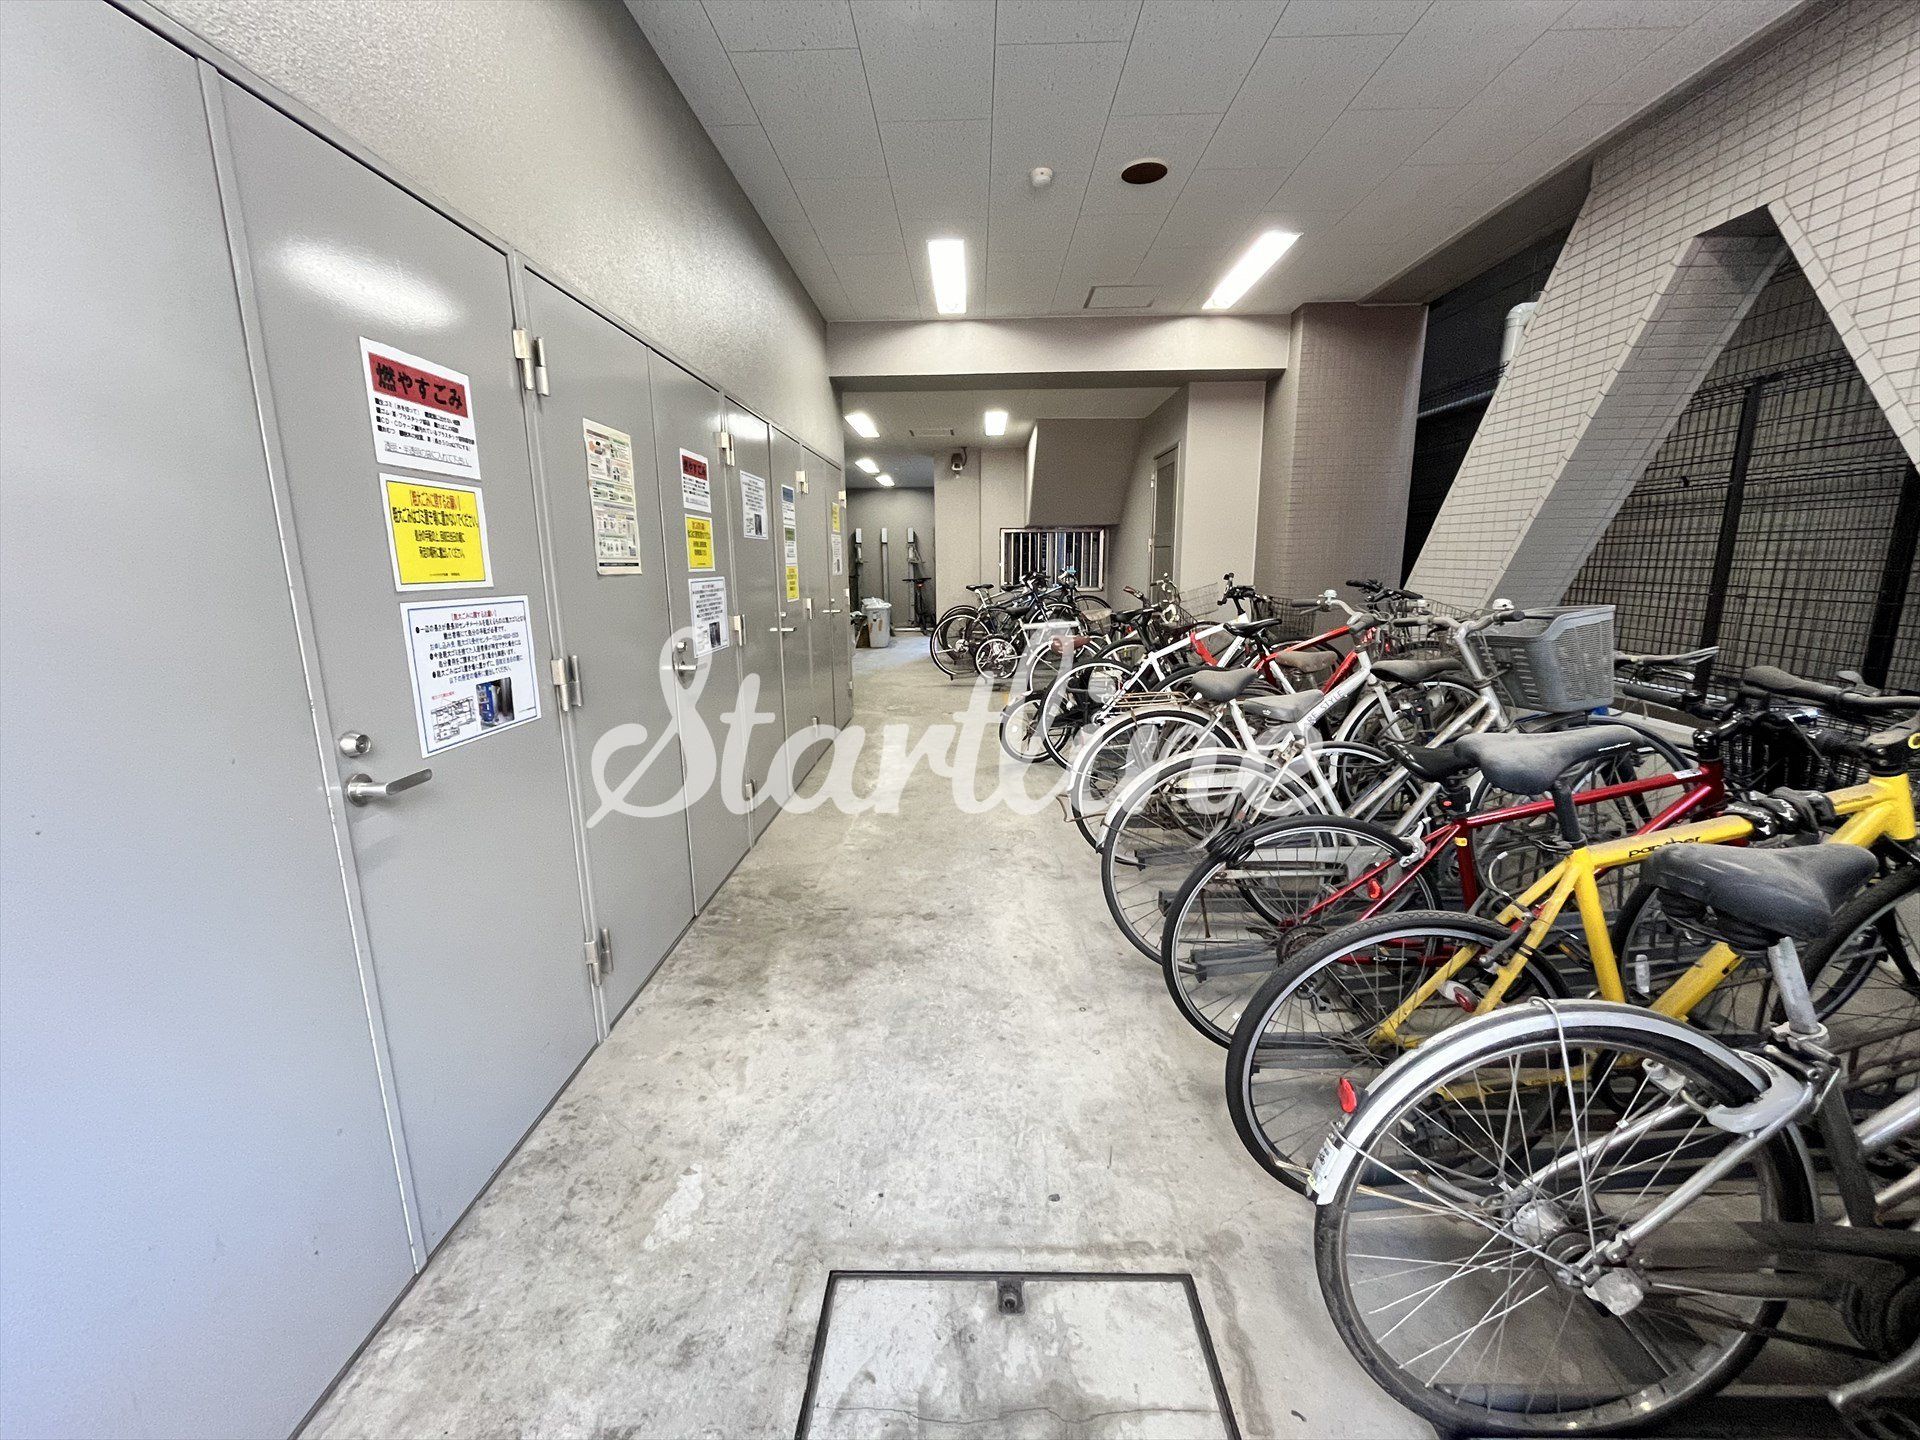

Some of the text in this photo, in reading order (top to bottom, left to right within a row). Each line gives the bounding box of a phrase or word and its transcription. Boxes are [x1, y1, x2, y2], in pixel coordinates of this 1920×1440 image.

[376, 362, 463, 410] 燃やすごみ
